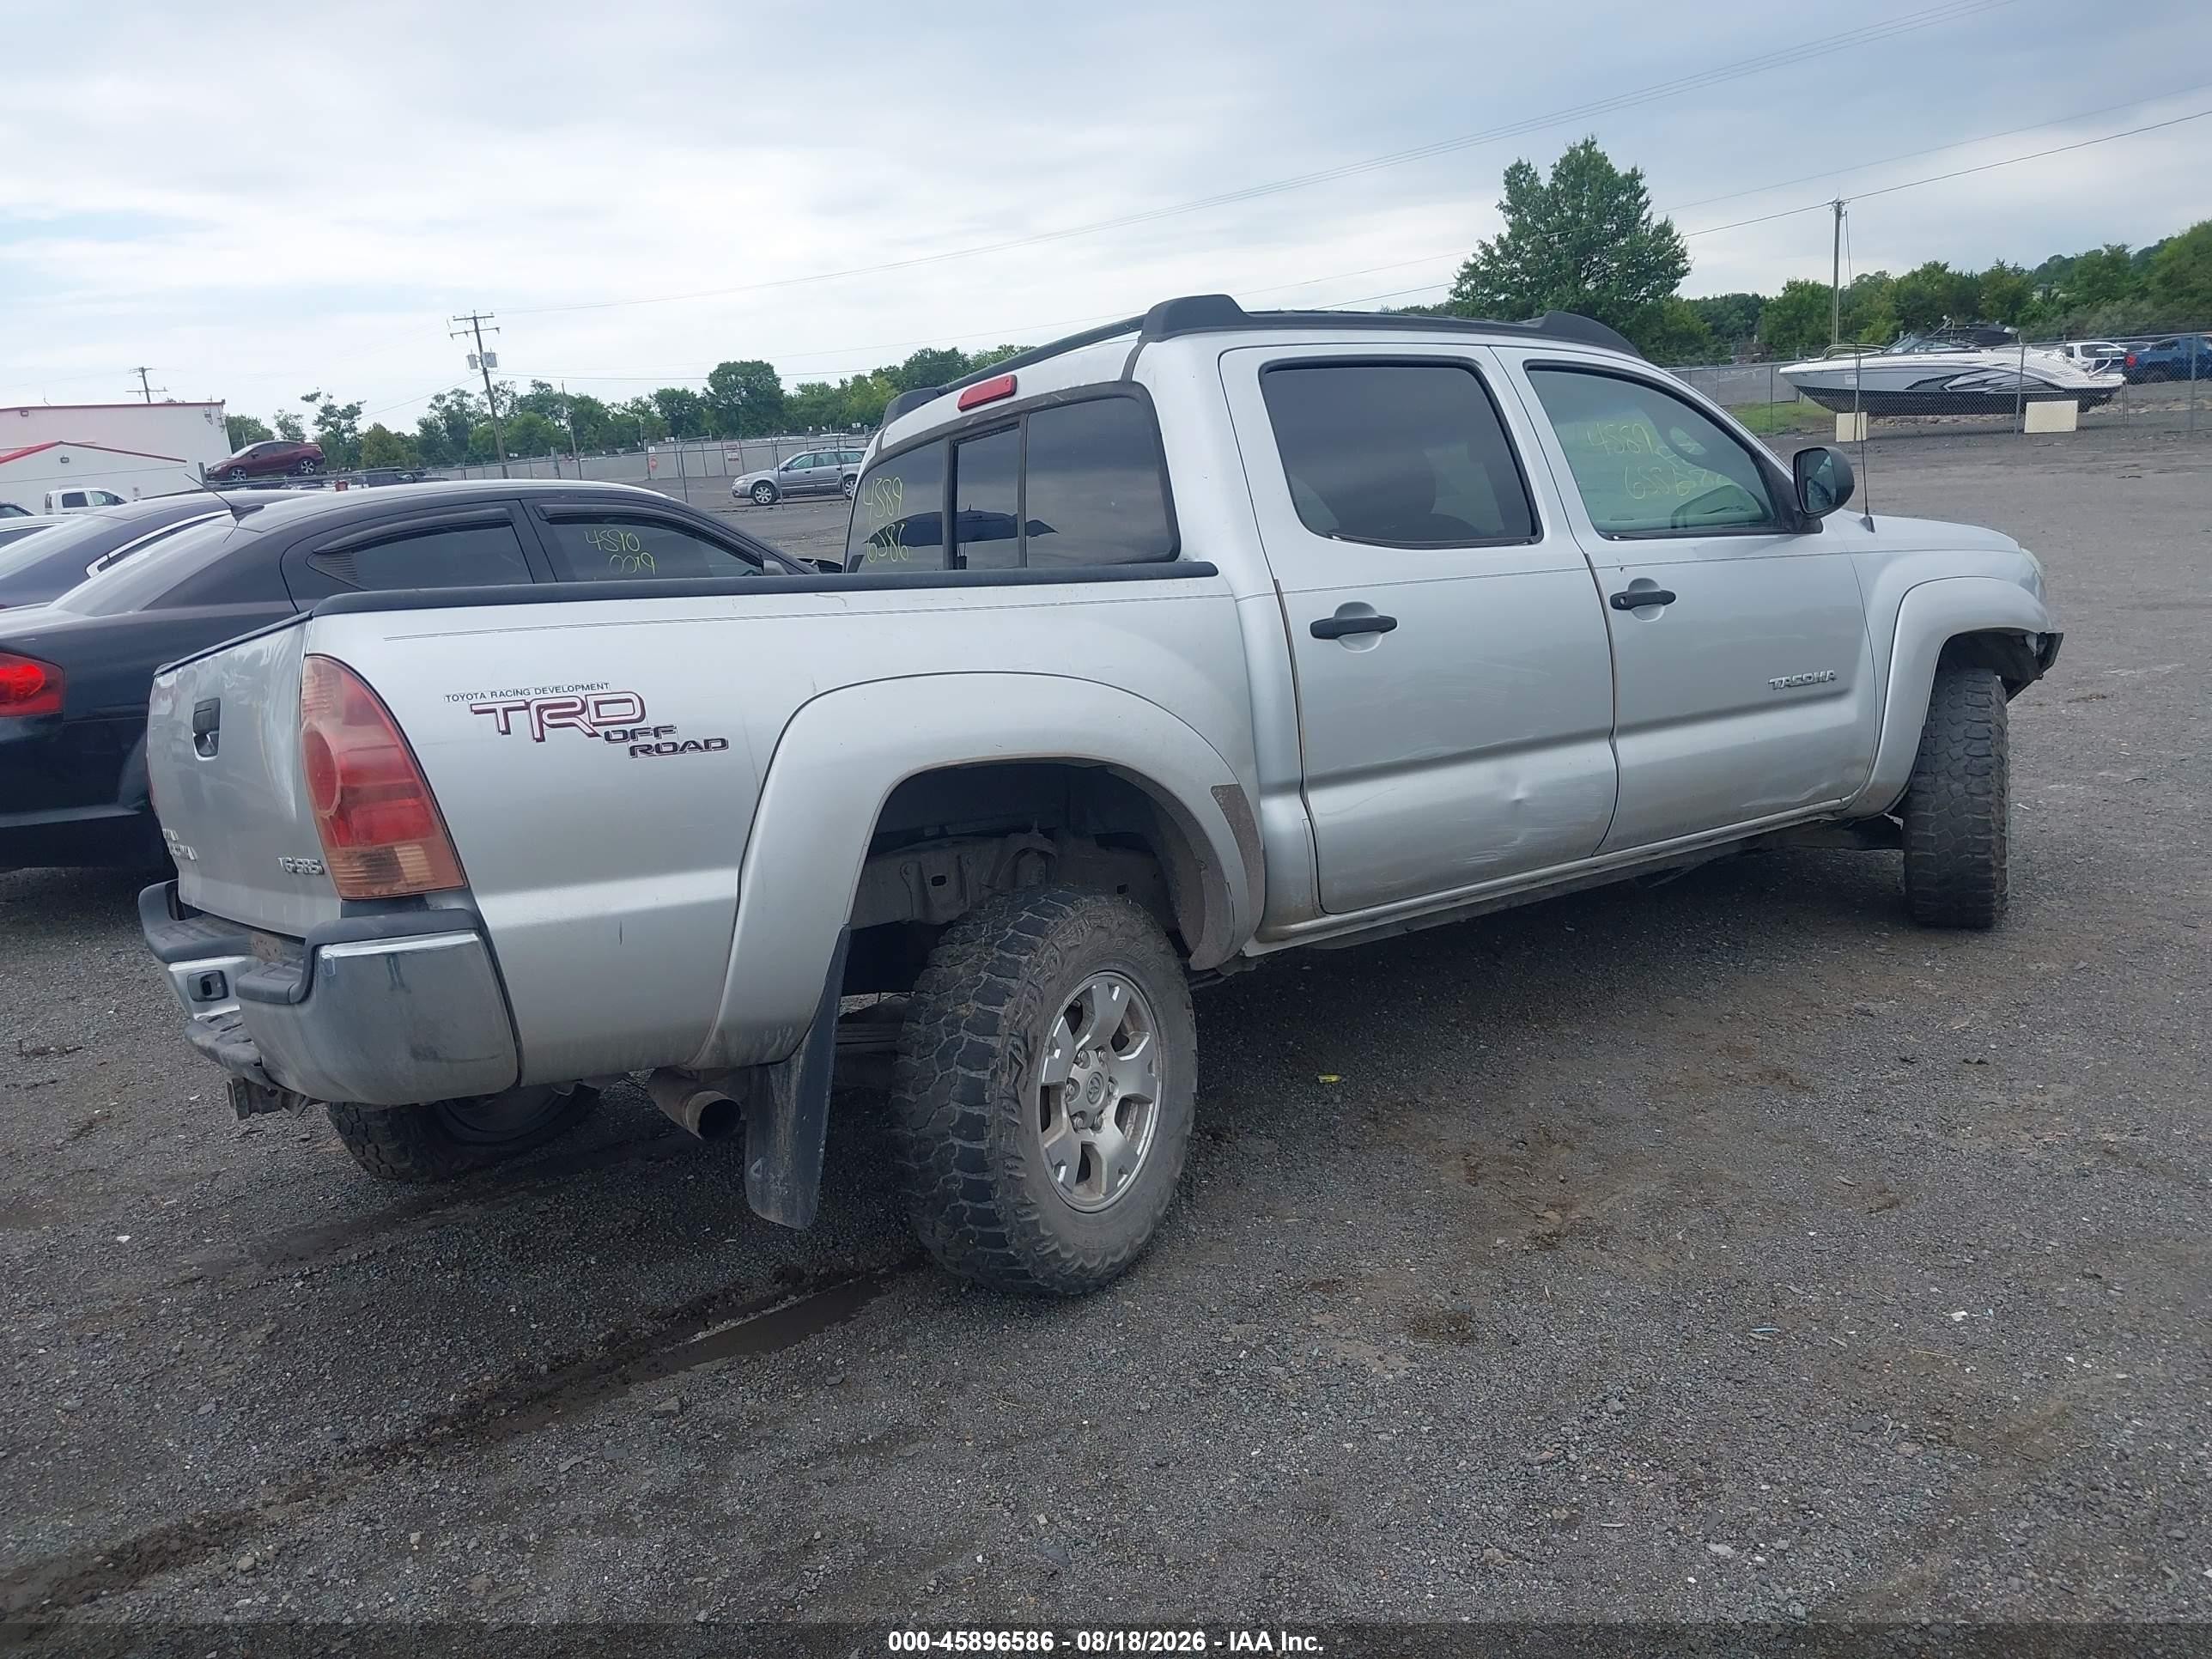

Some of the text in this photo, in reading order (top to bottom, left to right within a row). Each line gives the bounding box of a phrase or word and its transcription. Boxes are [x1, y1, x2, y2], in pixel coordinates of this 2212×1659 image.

[863, 477, 903, 525] 4589
[584, 529, 641, 552] 4590
[866, 523, 908, 563] 6586
[1768, 670, 1836, 690] TACOMA
[445, 682, 611, 703] TOYOTA RACING DEVELOPMENT
[470, 691, 647, 742] TRD
[604, 725, 678, 744] OFF
[629, 738, 729, 759] ROAD
